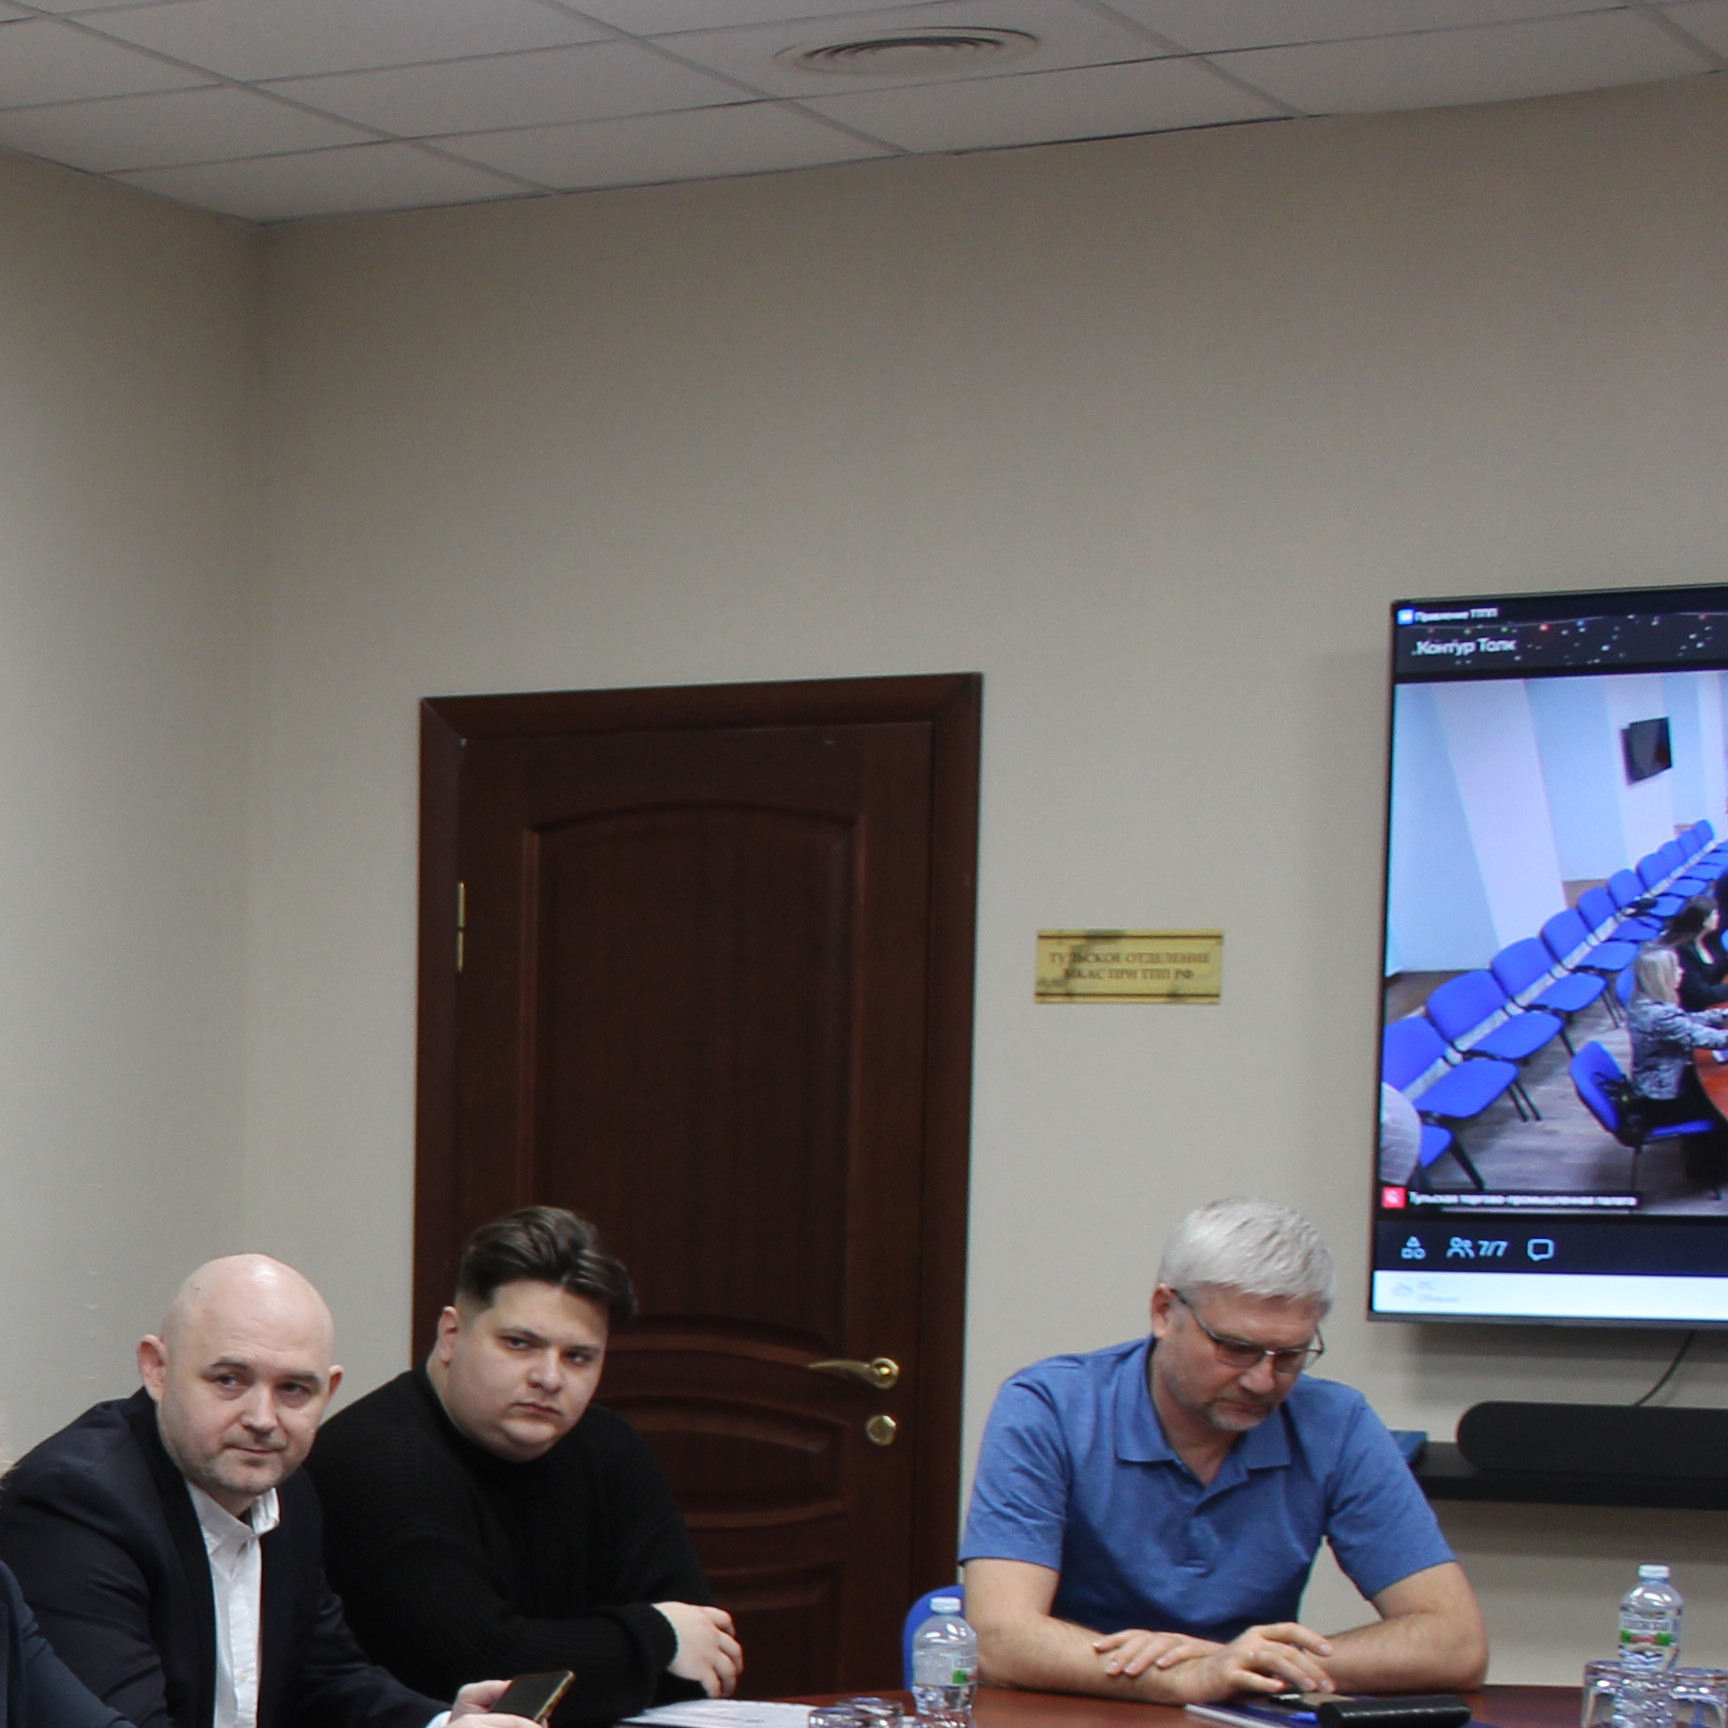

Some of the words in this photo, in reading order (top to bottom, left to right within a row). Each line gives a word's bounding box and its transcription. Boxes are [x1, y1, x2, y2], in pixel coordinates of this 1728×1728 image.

[1415, 639, 1476, 656] Контур
[1476, 637, 1517, 652] Толк
[1478, 1240, 1509, 1257] 7/7
